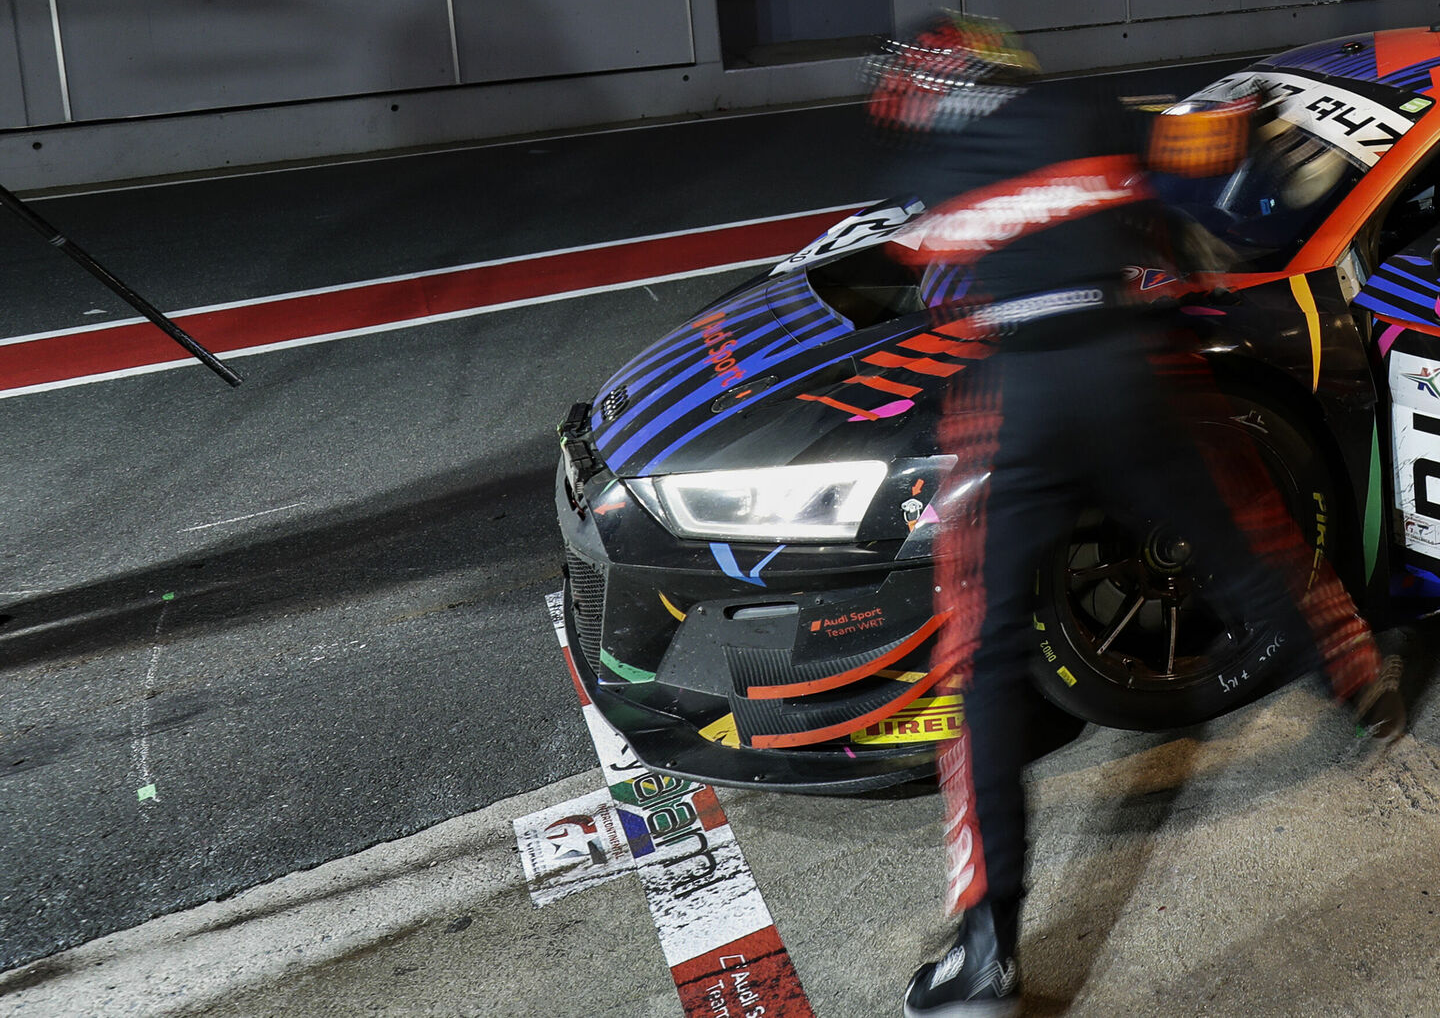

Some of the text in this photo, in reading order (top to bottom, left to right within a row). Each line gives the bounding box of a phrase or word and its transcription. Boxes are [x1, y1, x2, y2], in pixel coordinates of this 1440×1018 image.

[704, 339, 747, 388] Sport
[823, 607, 883, 627] Audi Sport
[826, 617, 885, 638] Team WRT
[730, 971, 760, 1008] Audi
